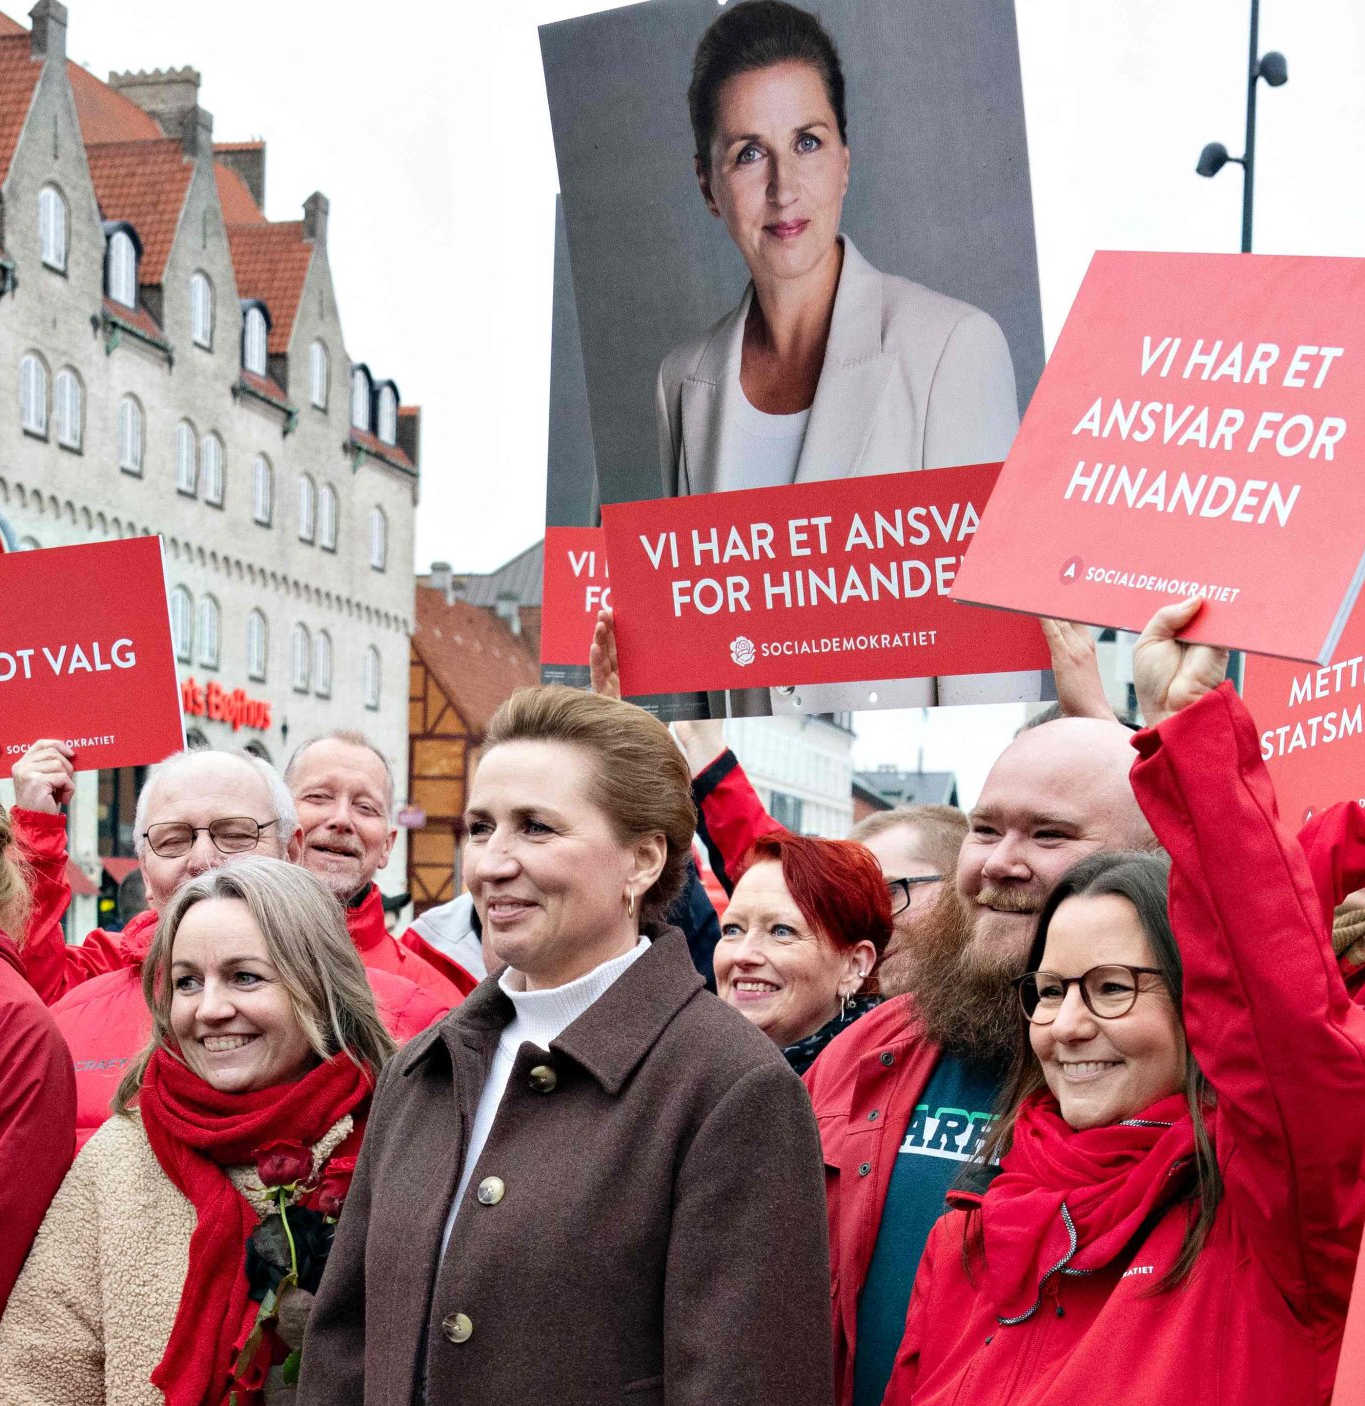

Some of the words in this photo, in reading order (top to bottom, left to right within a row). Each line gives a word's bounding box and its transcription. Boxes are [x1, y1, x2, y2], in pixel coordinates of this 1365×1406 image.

[1141, 335, 1182, 377] VI
[1182, 338, 1280, 385] HAR
[1282, 345, 1345, 389] ET
[1071, 396, 1245, 451] ANSVAR
[1247, 411, 1347, 461] FOR
[1063, 460, 1301, 528] HINANDEN
[639, 531, 679, 571] VI
[691, 522, 776, 565] HAR
[788, 516, 833, 557] ET
[844, 500, 981, 553] ANSVA
[567, 550, 595, 578] VI
[671, 576, 751, 617] FOR
[763, 555, 966, 610] HINANDE
[1085, 566, 1241, 603] SOCIALDEMOKRATIET
[42, 638, 136, 676] VALG
[761, 631, 938, 657] SOCIALDEMOKRATIET
[6, 735, 115, 755] SOCIOKRATIET
[75, 1058, 128, 1072] CRAFT
